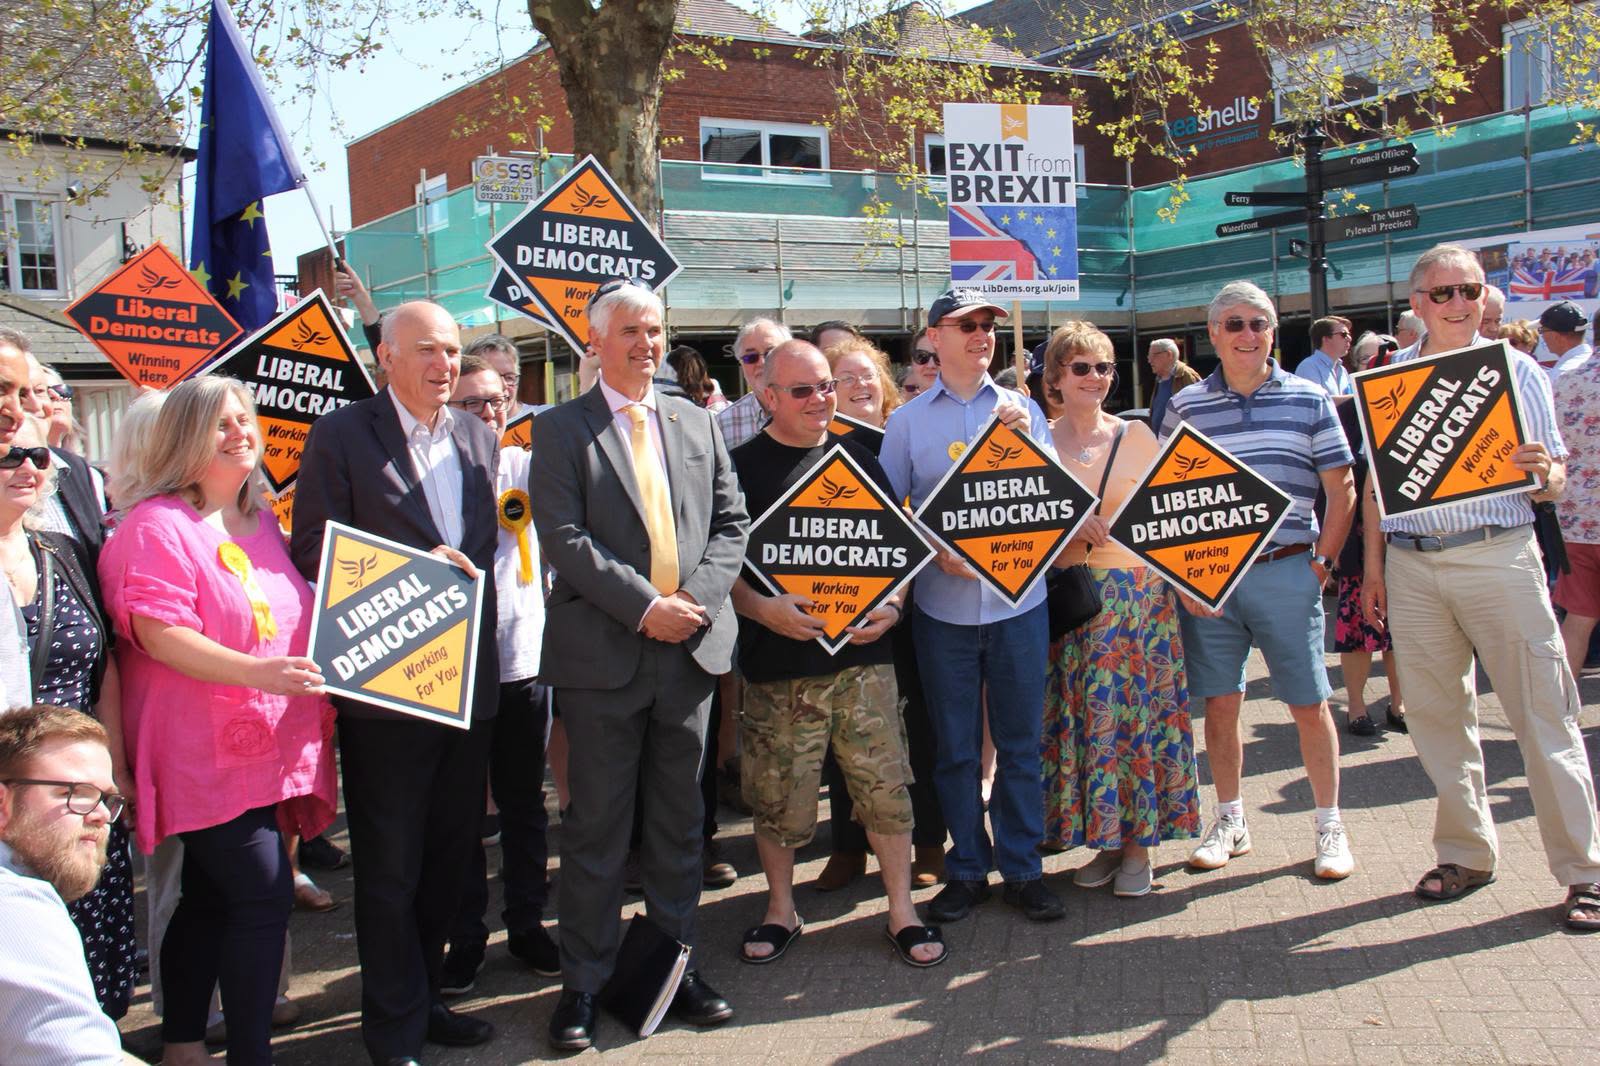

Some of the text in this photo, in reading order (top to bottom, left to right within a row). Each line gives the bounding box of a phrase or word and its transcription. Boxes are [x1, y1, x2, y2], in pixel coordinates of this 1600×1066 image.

[949, 143, 1071, 172] EXIT from
[1350, 153, 1380, 165] Council
[1388, 165, 1411, 173] Library
[951, 175, 1071, 203] BREXIT
[1231, 195, 1250, 204] Ferry
[1221, 221, 1258, 233] Waterfront
[1372, 213, 1386, 222] The
[542, 221, 633, 251] LIBERAL
[517, 245, 656, 280] DEMOCRATS
[565, 287, 594, 300] Work
[116, 298, 198, 324] Liberal
[564, 305, 582, 318] For
[90, 316, 220, 345] Democrats
[128, 352, 180, 370] Winning
[256, 355, 345, 391] LIBERAL
[139, 369, 168, 383] Here
[268, 424, 307, 442] Workin
[1389, 377, 1462, 465] LIBERAL
[1398, 365, 1500, 501] DEMOCRATS
[264, 444, 300, 461] For Yo
[1461, 427, 1499, 474] Working
[1478, 440, 1515, 484] For You
[963, 476, 1050, 503] LIBERAL
[1151, 482, 1242, 514] LIBERAL
[942, 499, 1074, 531] DEMOCRATS
[1131, 503, 1269, 544] DEMOCRATS
[789, 516, 883, 540] LIBERAL
[762, 543, 907, 568] DEMOCRATS
[990, 539, 1033, 554] Working
[1184, 546, 1229, 562] Working
[991, 557, 1033, 572] For You
[1187, 563, 1230, 579] For You
[811, 581, 859, 597] Working
[336, 573, 431, 639] LIBERAL
[811, 600, 857, 614] For You
[331, 584, 468, 681] DEMOCRATS
[402, 646, 448, 681] Working
[416, 665, 458, 700] For You
